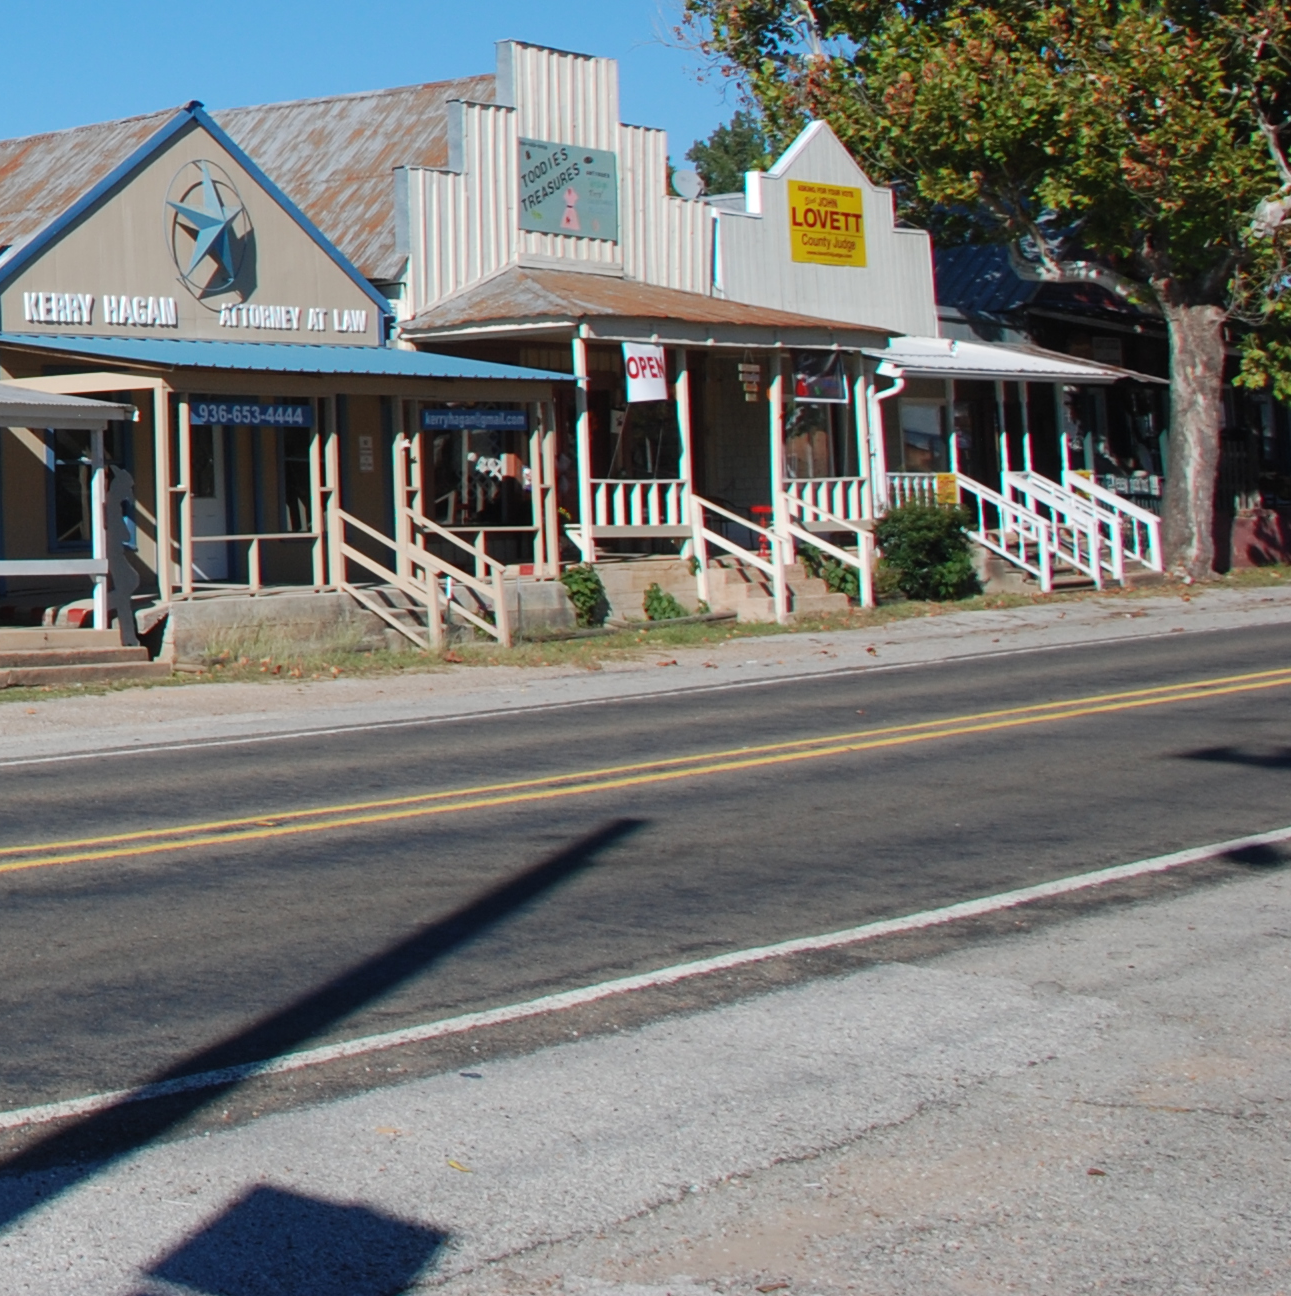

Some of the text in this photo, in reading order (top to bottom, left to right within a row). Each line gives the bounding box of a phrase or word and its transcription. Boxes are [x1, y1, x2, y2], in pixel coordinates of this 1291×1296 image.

[521, 147, 569, 188] TOODIES
[521, 162, 581, 212] TREASURES
[792, 206, 862, 233] LOVETT
[802, 233, 856, 252] County Judge
[24, 291, 367, 332] KERRY HAGAN ATTORNEY AT LAW
[627, 356, 665, 379] OPEN
[199, 404, 303, 424] 936-653-4444
[425, 411, 525, 428] kerryhagan@gmail.com
